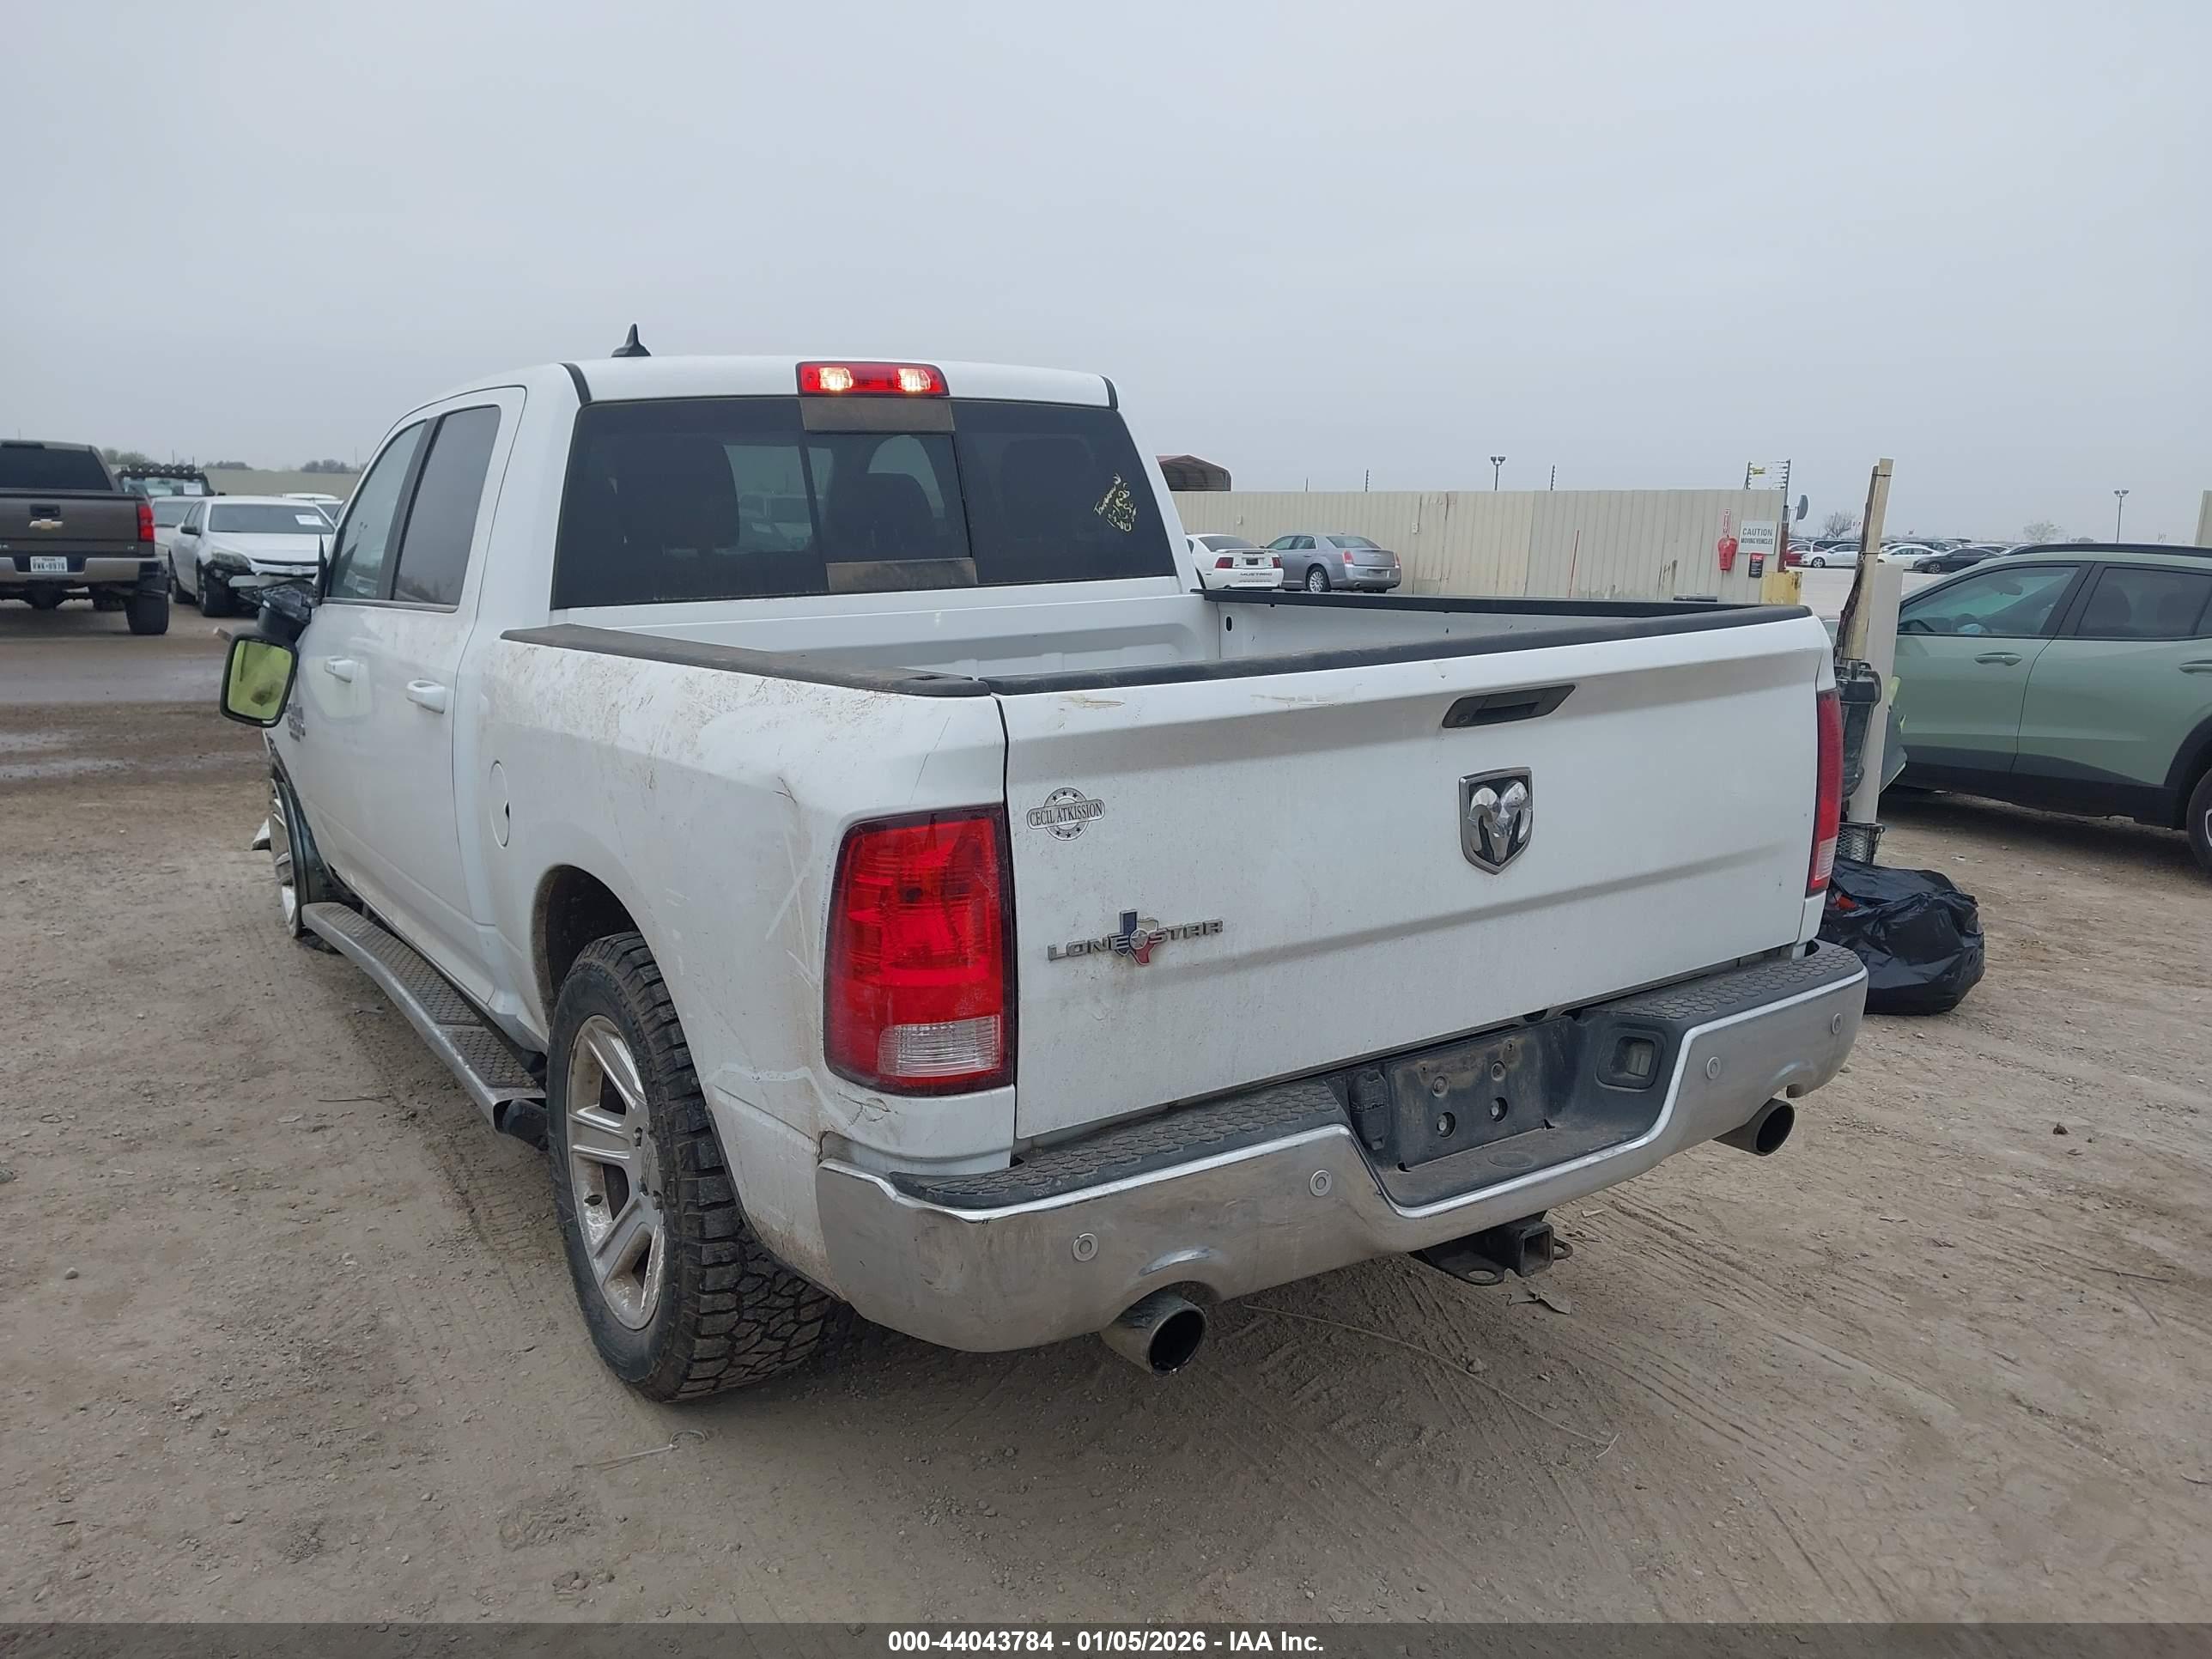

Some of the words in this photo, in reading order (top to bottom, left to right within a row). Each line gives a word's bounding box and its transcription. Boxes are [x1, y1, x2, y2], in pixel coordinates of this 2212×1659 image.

[1742, 527, 1773, 537] CAUTION
[1030, 809, 1055, 827] CECIL
[1056, 802, 1103, 823] ATKISSION
[1047, 933, 1130, 961] LONE
[1148, 919, 1224, 945] STAR
